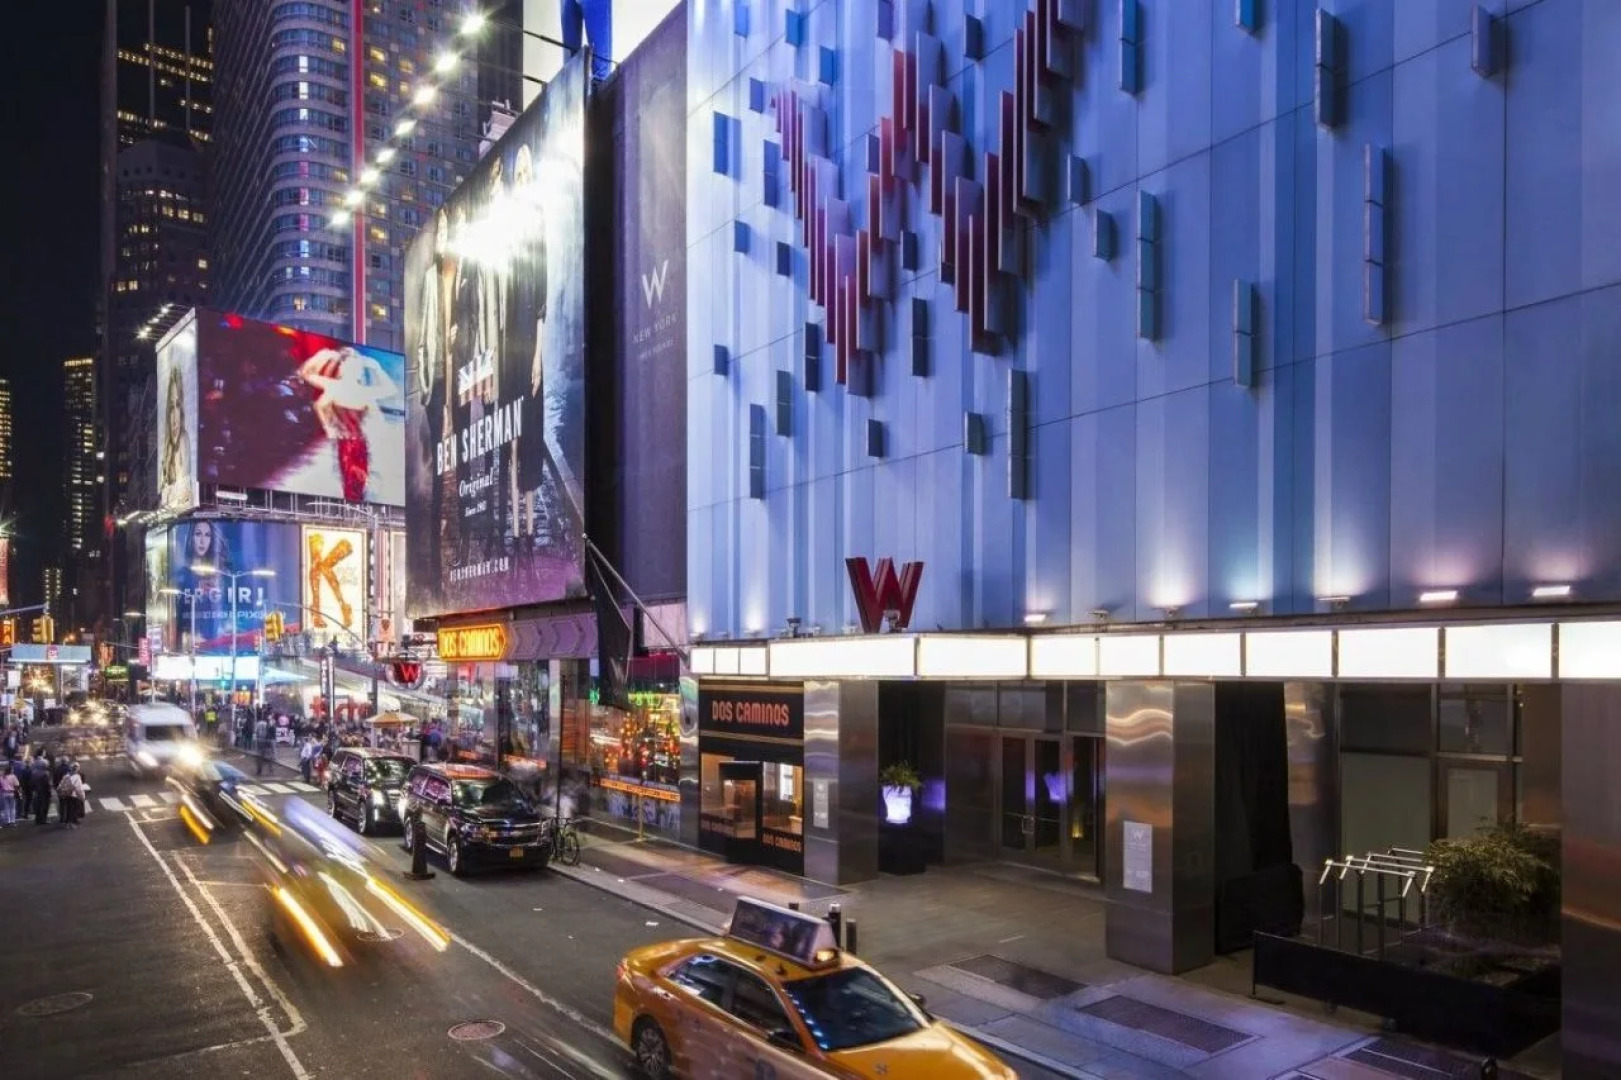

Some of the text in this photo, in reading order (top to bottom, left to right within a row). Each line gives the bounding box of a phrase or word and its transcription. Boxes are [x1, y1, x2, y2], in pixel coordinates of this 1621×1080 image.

[641, 259, 669, 309] W
[437, 397, 524, 475] BEN SHERMAN
[459, 466, 494, 498] Original
[309, 532, 353, 628] K
[845, 556, 924, 634] W
[440, 631, 457, 657] DOS
[400, 662, 420, 681] W
[711, 700, 790, 726] DOS CAMINOS
